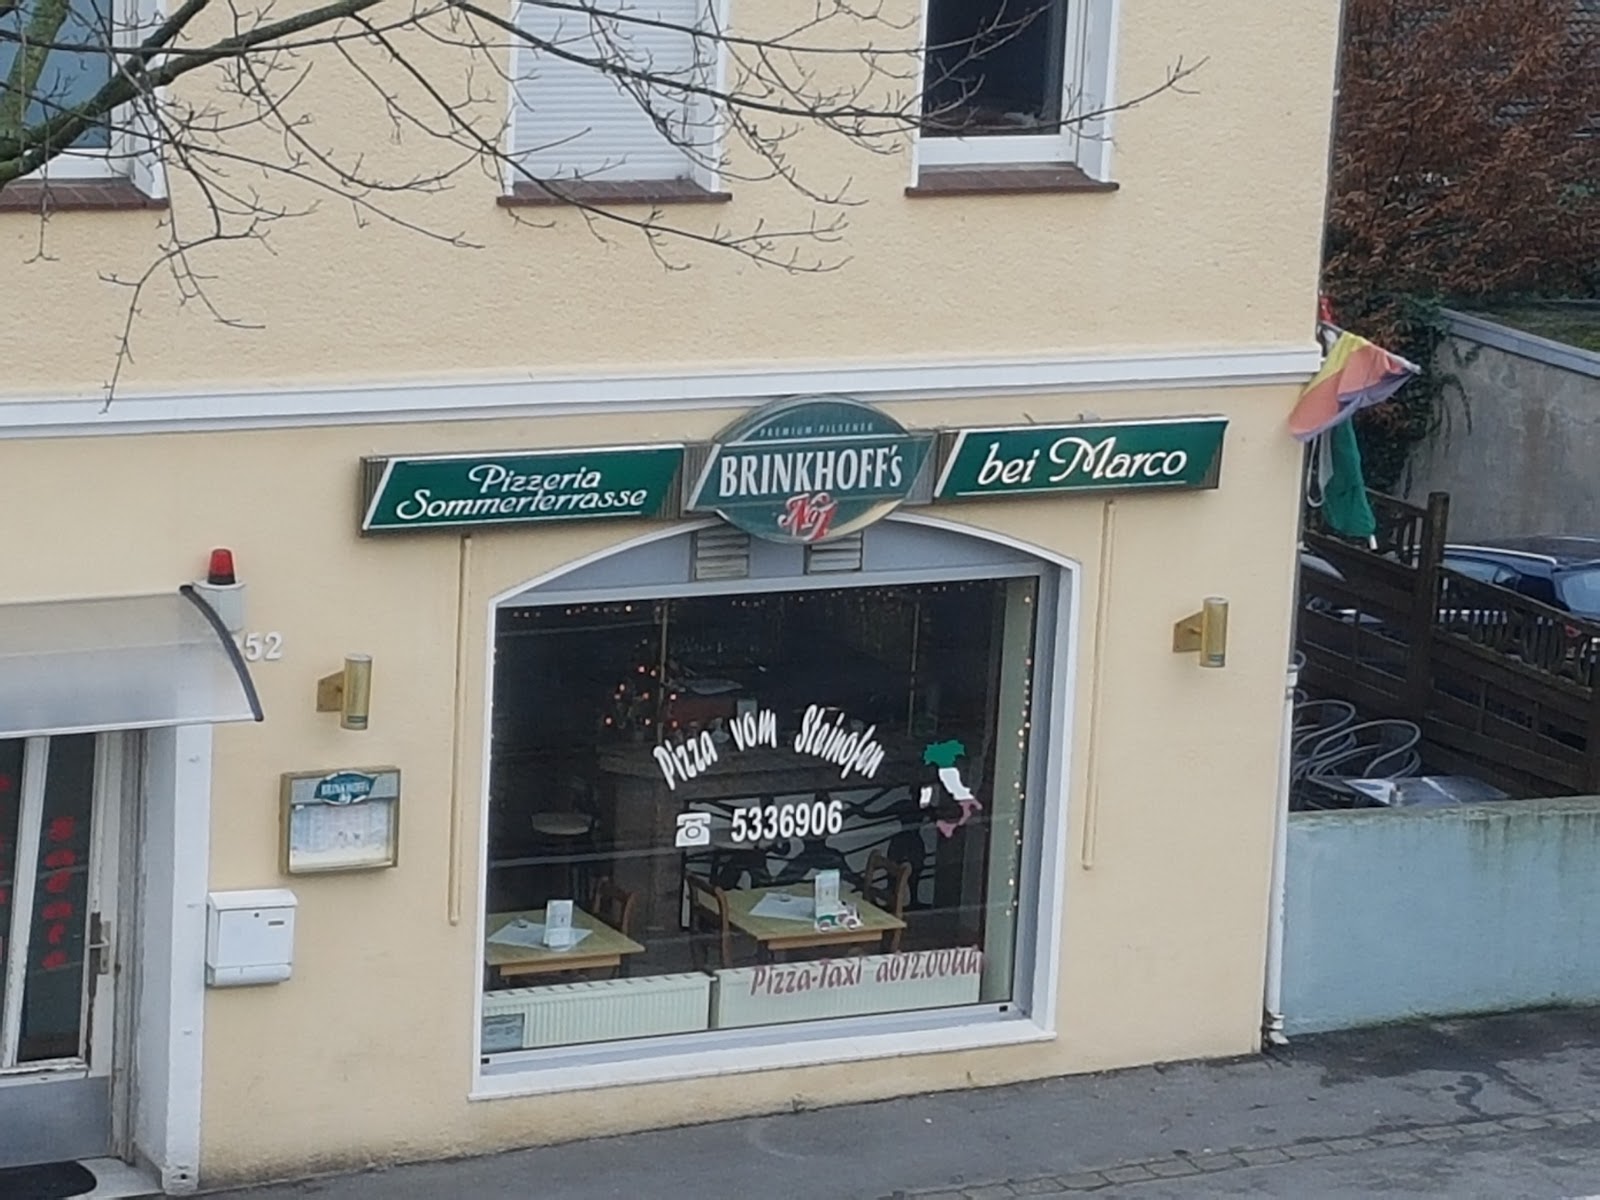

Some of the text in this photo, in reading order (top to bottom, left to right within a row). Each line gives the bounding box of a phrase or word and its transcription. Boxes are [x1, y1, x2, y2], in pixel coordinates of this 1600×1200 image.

[468, 463, 601, 494] Pizzeria
[977, 435, 1188, 486] bei Marco
[396, 488, 648, 520] Sommerterrasse
[245, 631, 282, 661] 52
[652, 730, 719, 791] Pizza
[794, 703, 886, 780] Steinofen
[730, 800, 844, 843] 5336906
[750, 956, 864, 996] Pizza-Taxi
